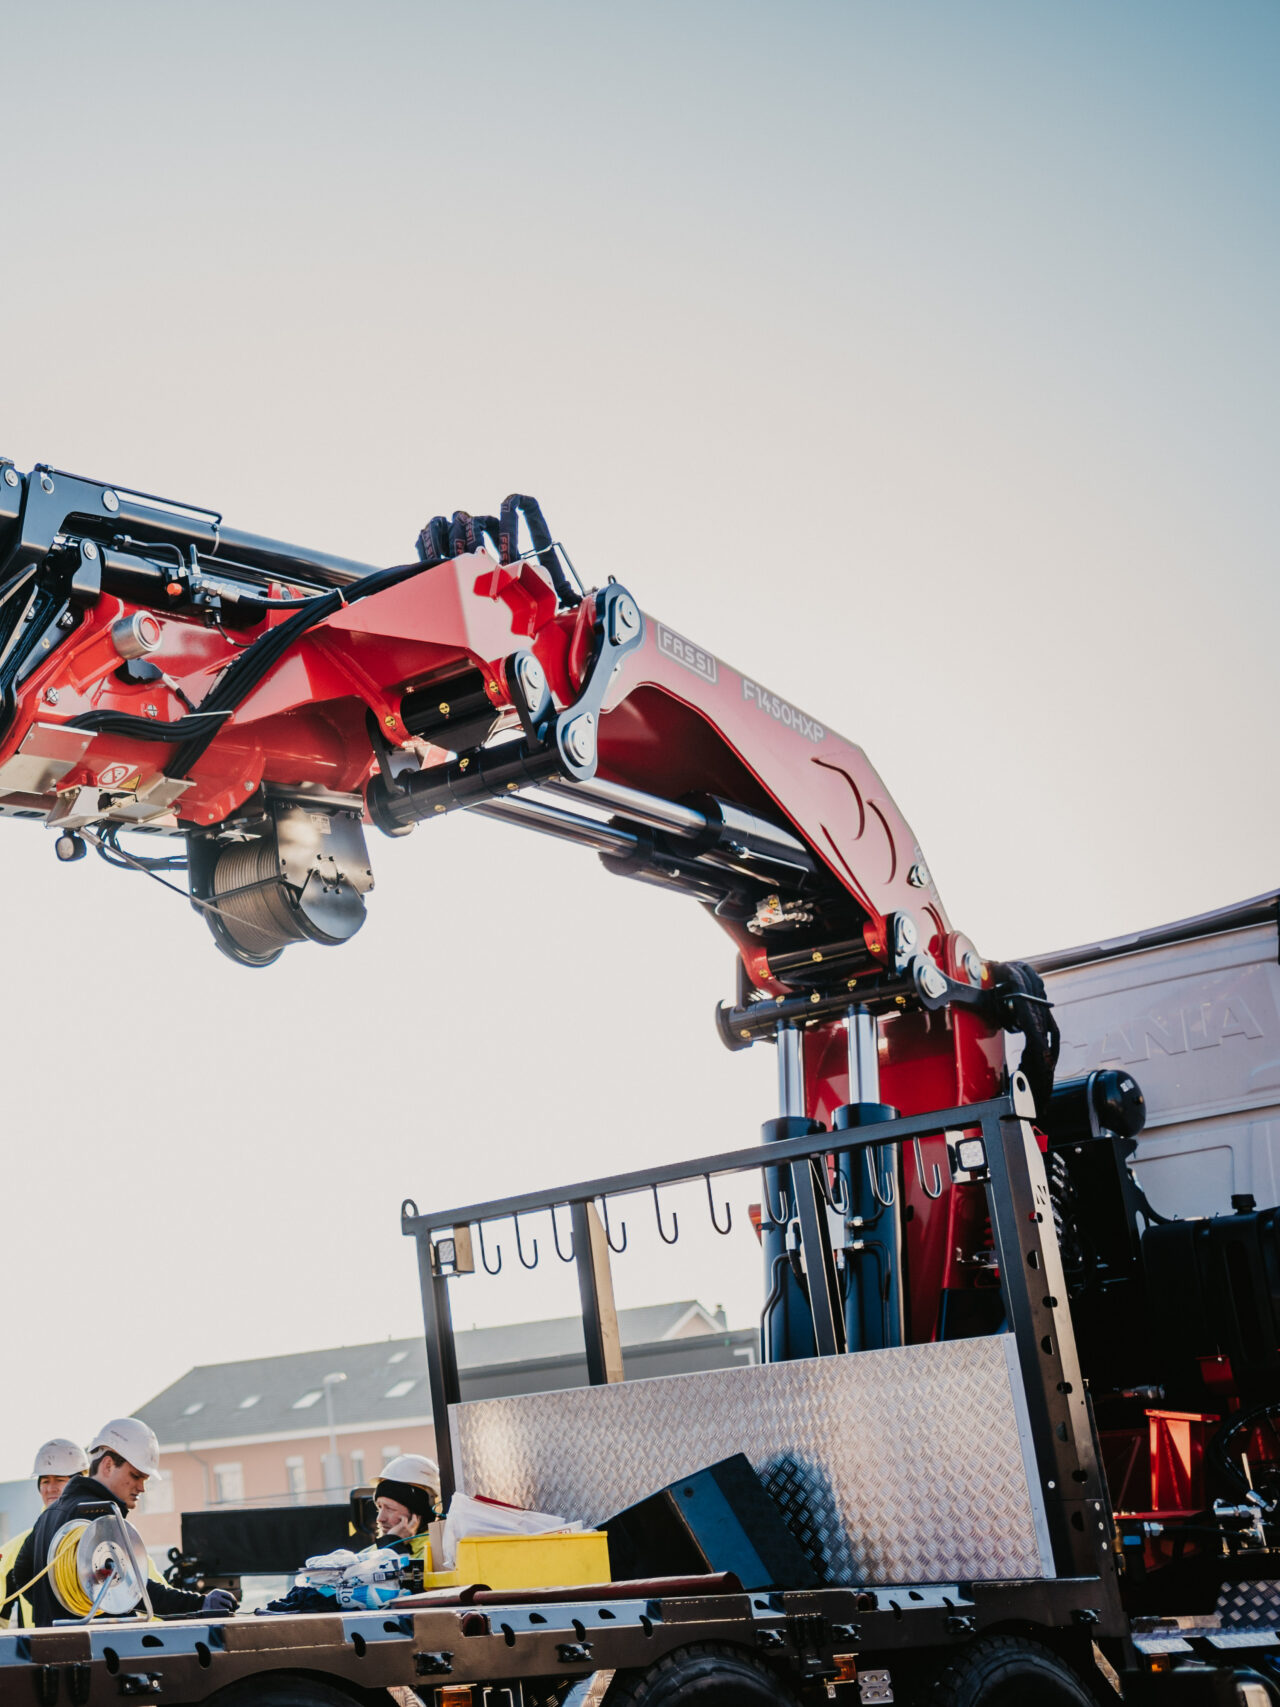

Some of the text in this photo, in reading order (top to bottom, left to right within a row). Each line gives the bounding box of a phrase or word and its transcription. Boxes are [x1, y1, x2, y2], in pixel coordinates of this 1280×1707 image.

[662, 630, 713, 675] FASSI
[743, 678, 824, 744] F1450HXP
[1012, 996, 1264, 1079] CANIA
